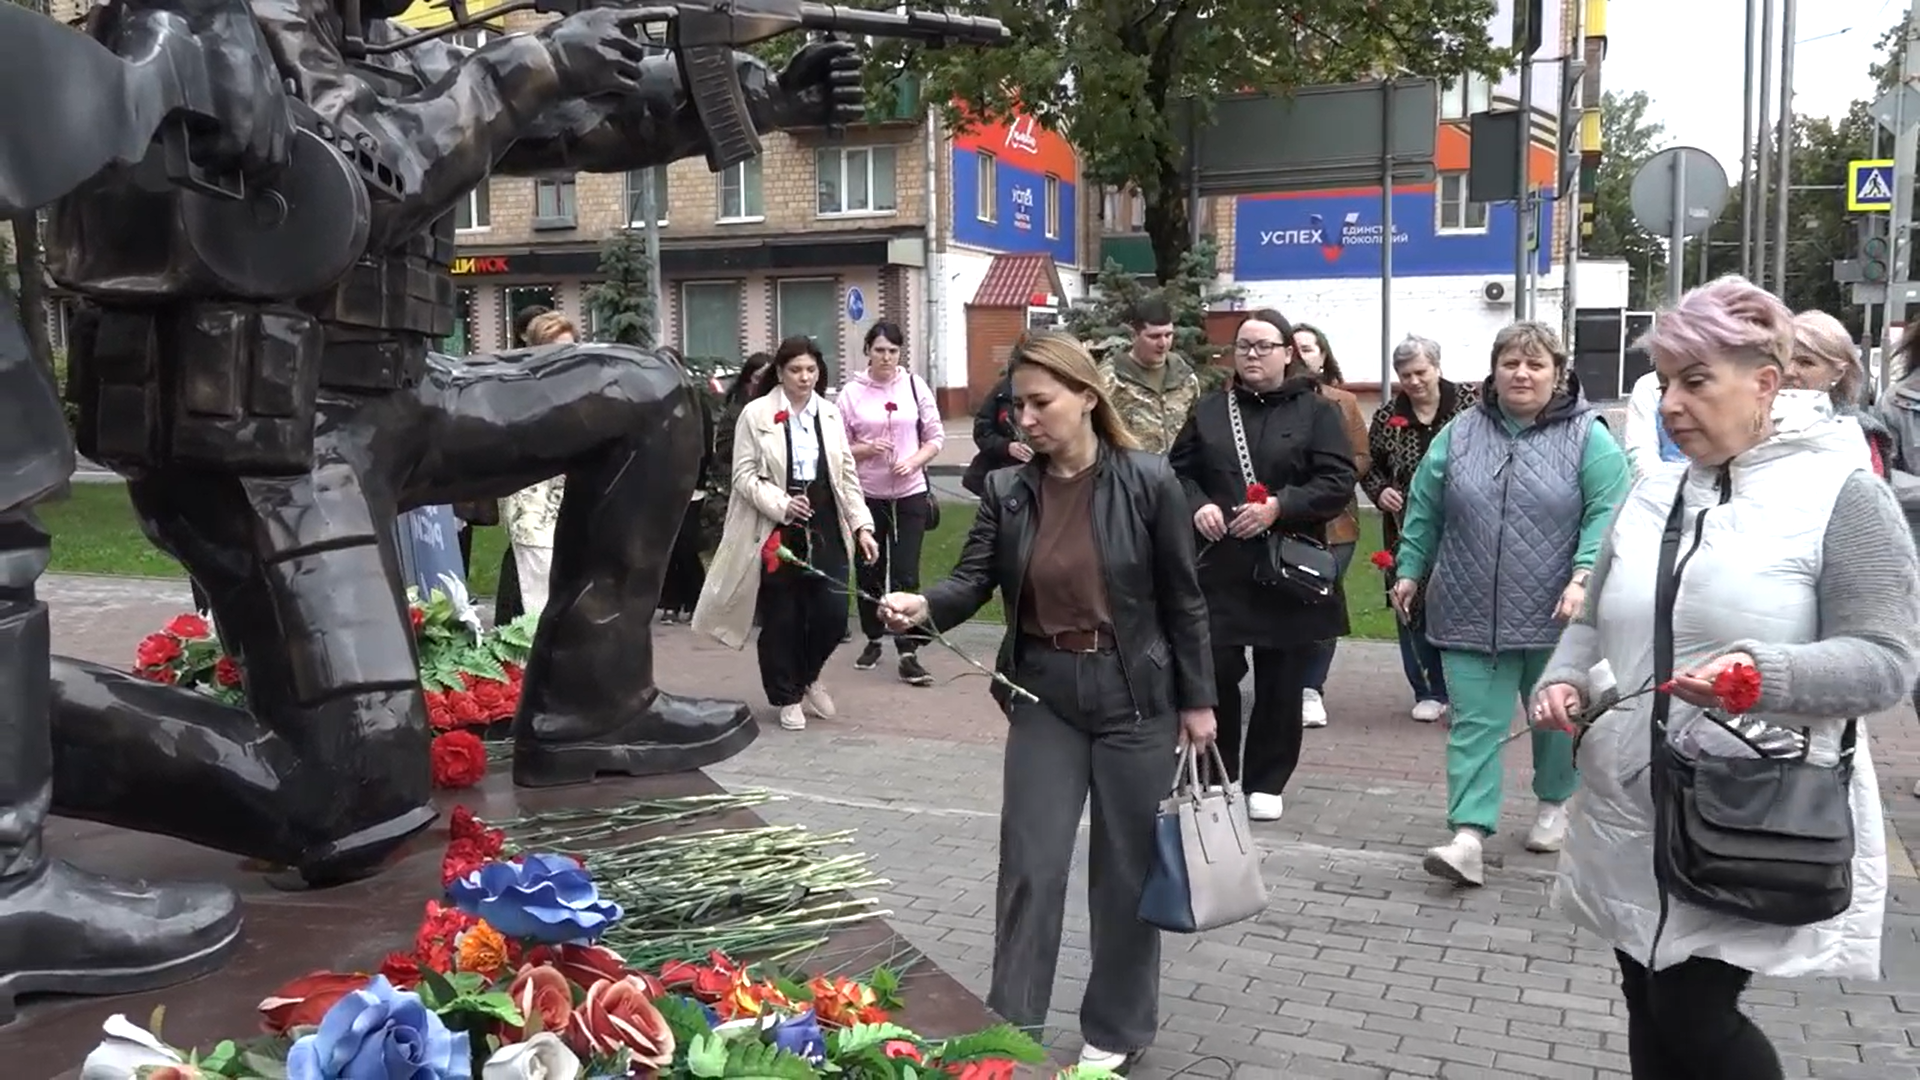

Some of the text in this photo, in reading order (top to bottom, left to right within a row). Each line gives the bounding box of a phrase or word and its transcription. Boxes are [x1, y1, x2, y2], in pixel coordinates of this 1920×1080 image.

[1342, 224, 1398, 235] ЕДИНСТЕ
[1260, 229, 1323, 246] УСПЕХ
[1342, 233, 1409, 245] ПОКОЛИЙ
